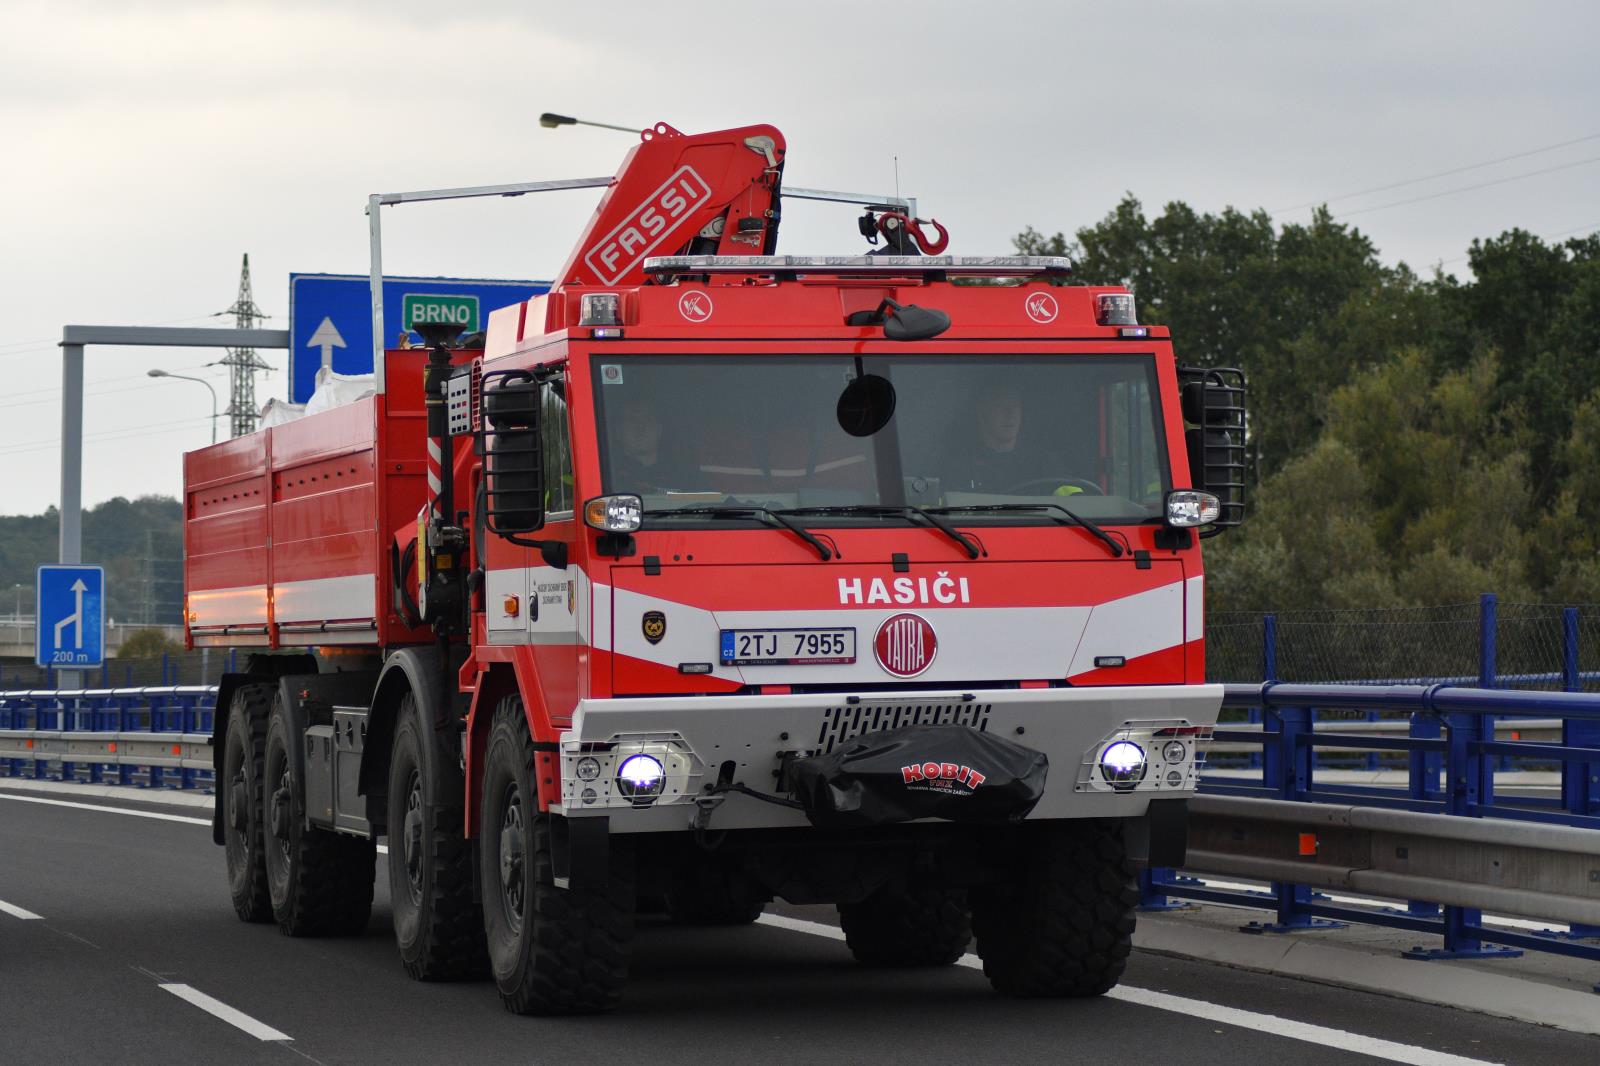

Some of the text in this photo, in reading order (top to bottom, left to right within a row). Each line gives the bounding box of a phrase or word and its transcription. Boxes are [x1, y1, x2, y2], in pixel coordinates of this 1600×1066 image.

[600, 179, 698, 272] FASSI
[412, 303, 471, 324] BRNO
[838, 571, 970, 604] HASIČI
[53, 651, 88, 662] 200 m
[739, 633, 845, 657] 2TJ 7955
[885, 618, 925, 672] TATRA
[901, 762, 986, 790] KOBIT
